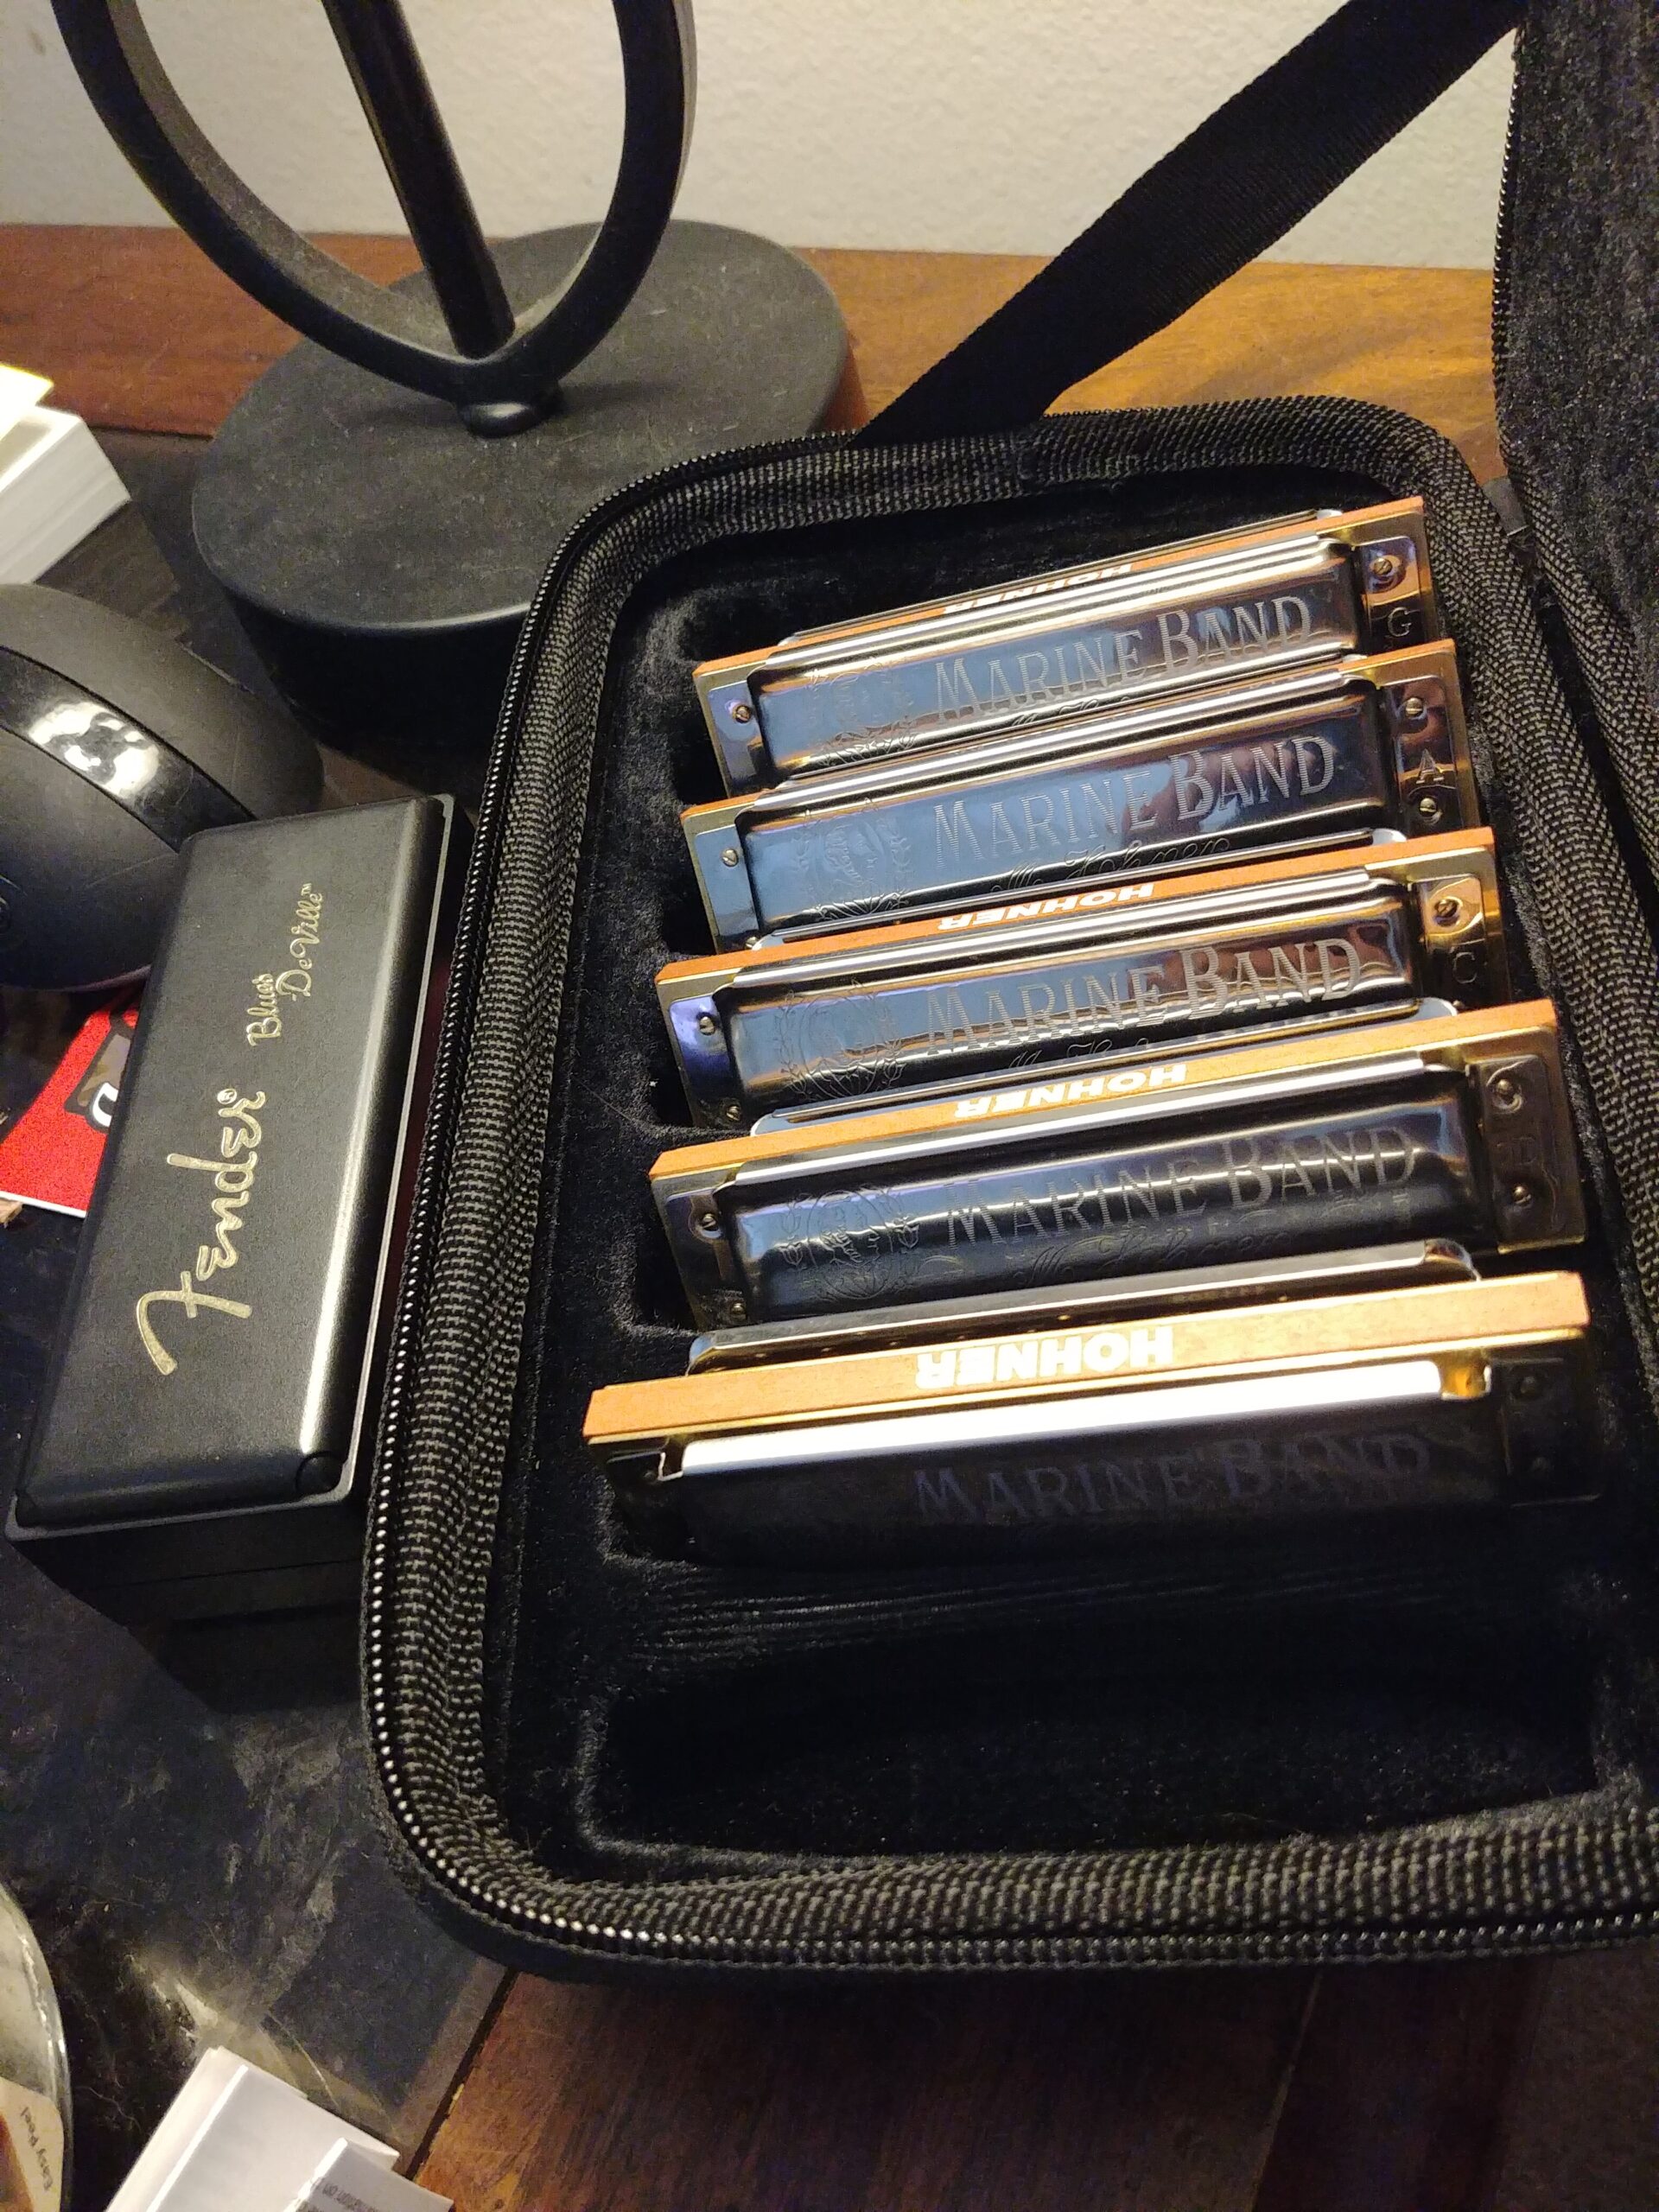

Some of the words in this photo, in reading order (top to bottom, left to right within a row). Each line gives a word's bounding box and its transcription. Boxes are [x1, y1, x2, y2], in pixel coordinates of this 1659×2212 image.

[1388, 607, 1412, 638] G
[936, 628, 1147, 724] MARINE
[1156, 595, 1312, 671] BAND
[1416, 747, 1445, 785] A
[932, 769, 1159, 871] MARINE
[1166, 735, 1335, 822] BAND
[937, 884, 1155, 931] HOHNER
[926, 964, 1168, 1056] MARINE
[1178, 938, 1361, 1020] BAND
[1452, 951, 1478, 984] C
[245, 972, 283, 1046] Blues
[953, 1064, 1188, 1119] HOHNER
[944, 1159, 1208, 1251] MARINE
[1222, 1127, 1420, 1210] BAND
[915, 1325, 1173, 1389] HOHNER
[912, 1452, 1212, 1526] MARINE
[1218, 1431, 1431, 1502] BAND
